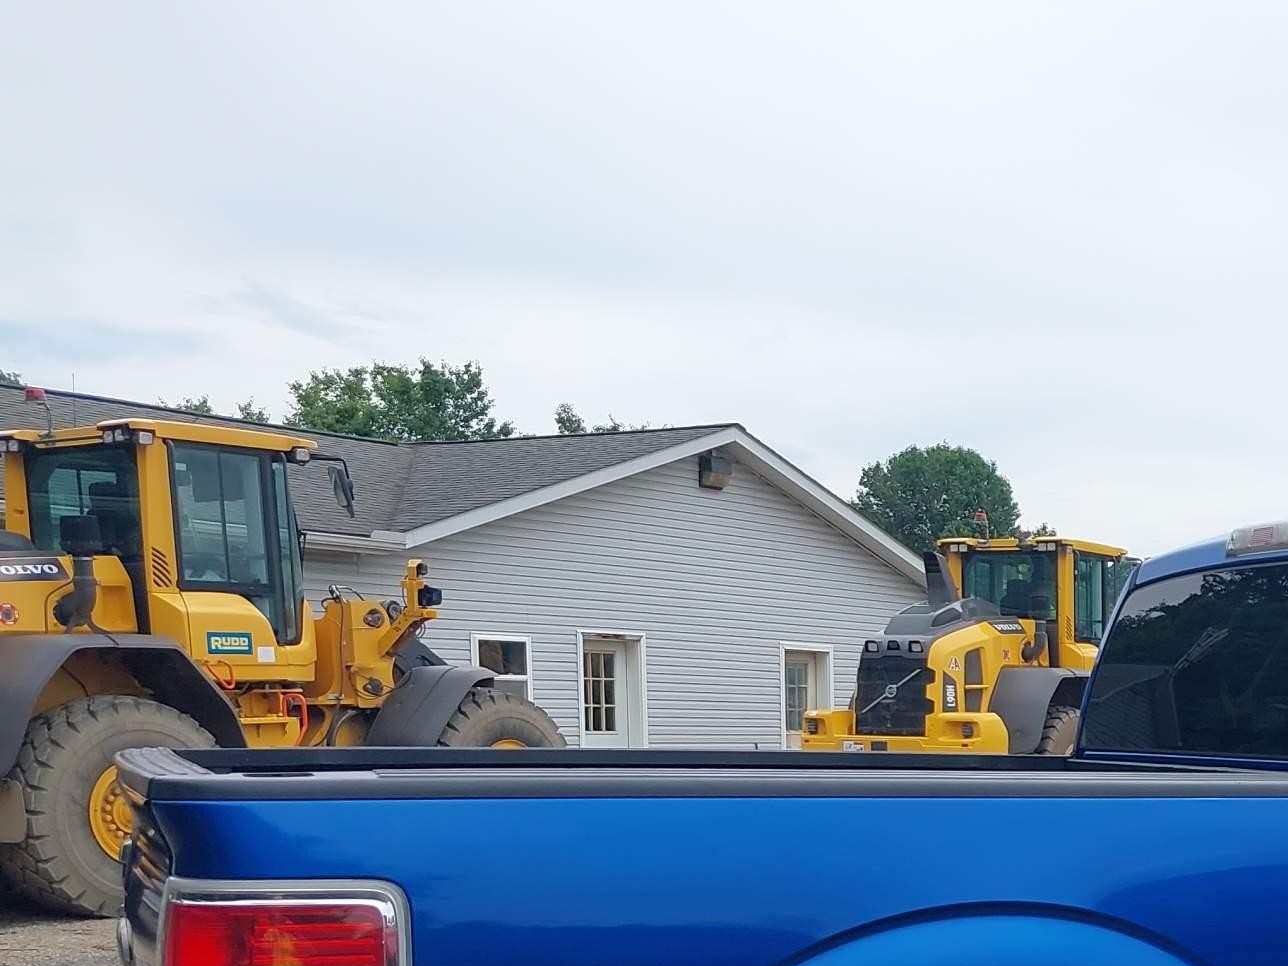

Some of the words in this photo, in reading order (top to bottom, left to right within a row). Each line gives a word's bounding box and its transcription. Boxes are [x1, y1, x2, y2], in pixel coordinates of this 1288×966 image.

[0, 564, 59, 575] OLVO
[992, 623, 1022, 631] VOLVO
[210, 636, 249, 650] RUDD
